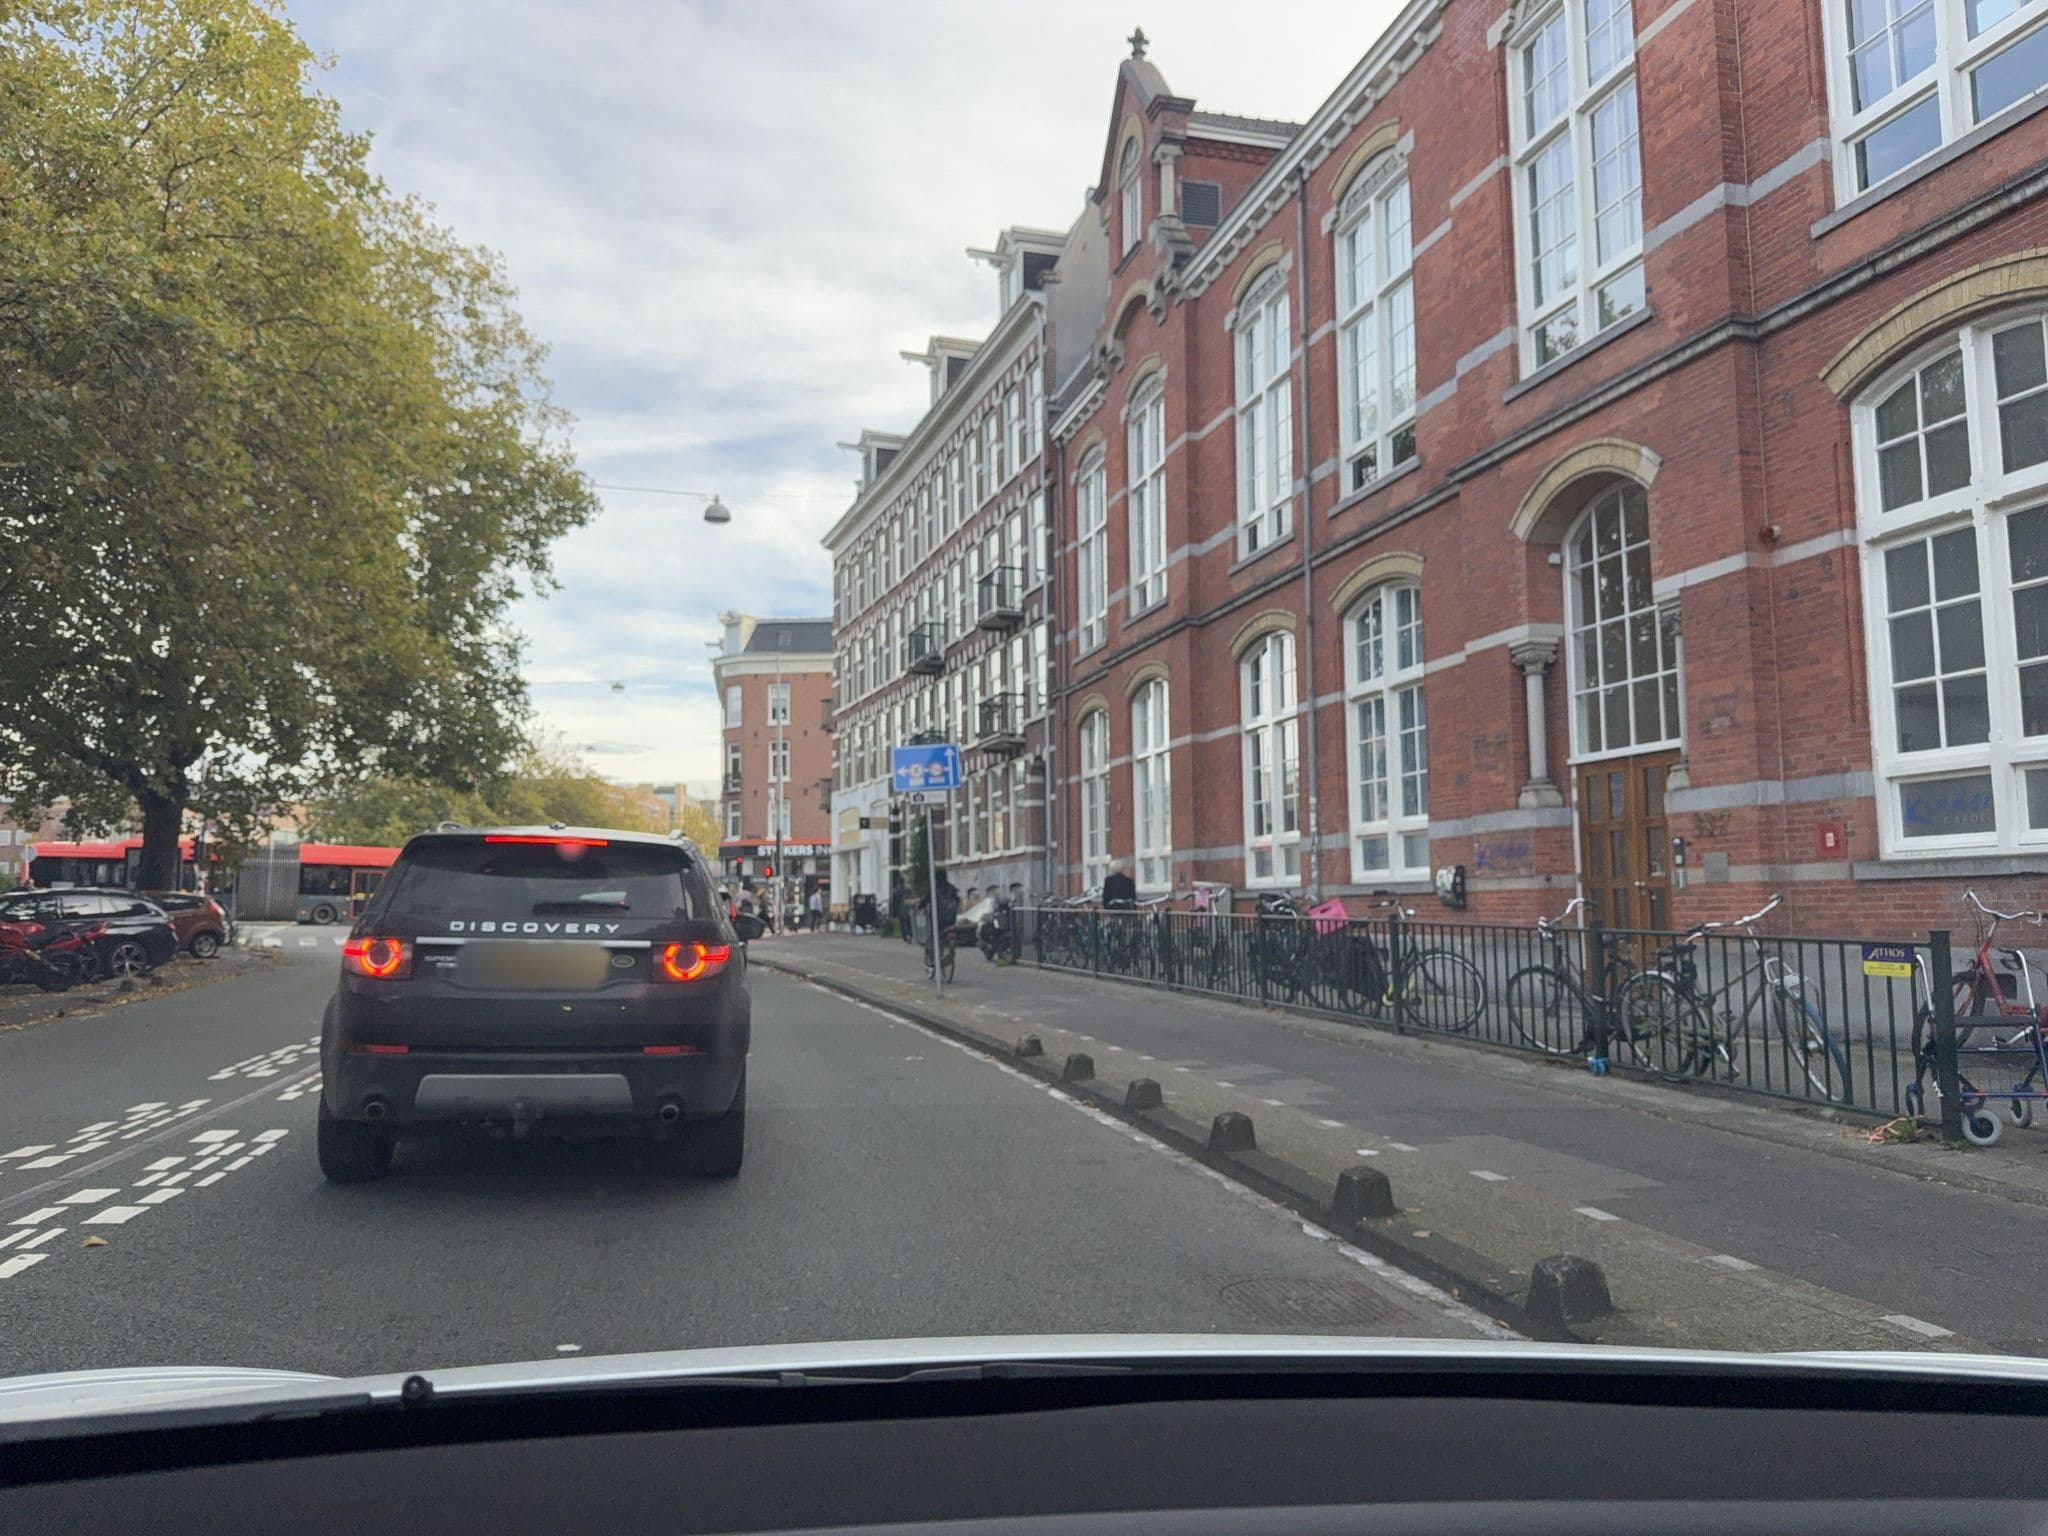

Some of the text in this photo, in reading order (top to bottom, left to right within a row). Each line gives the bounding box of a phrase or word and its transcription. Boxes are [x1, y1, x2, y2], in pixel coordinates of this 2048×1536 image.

[758, 845, 813, 857] STKERS
[449, 921, 620, 934] DISCOVERY
[1868, 947, 1904, 960] ATHOS
